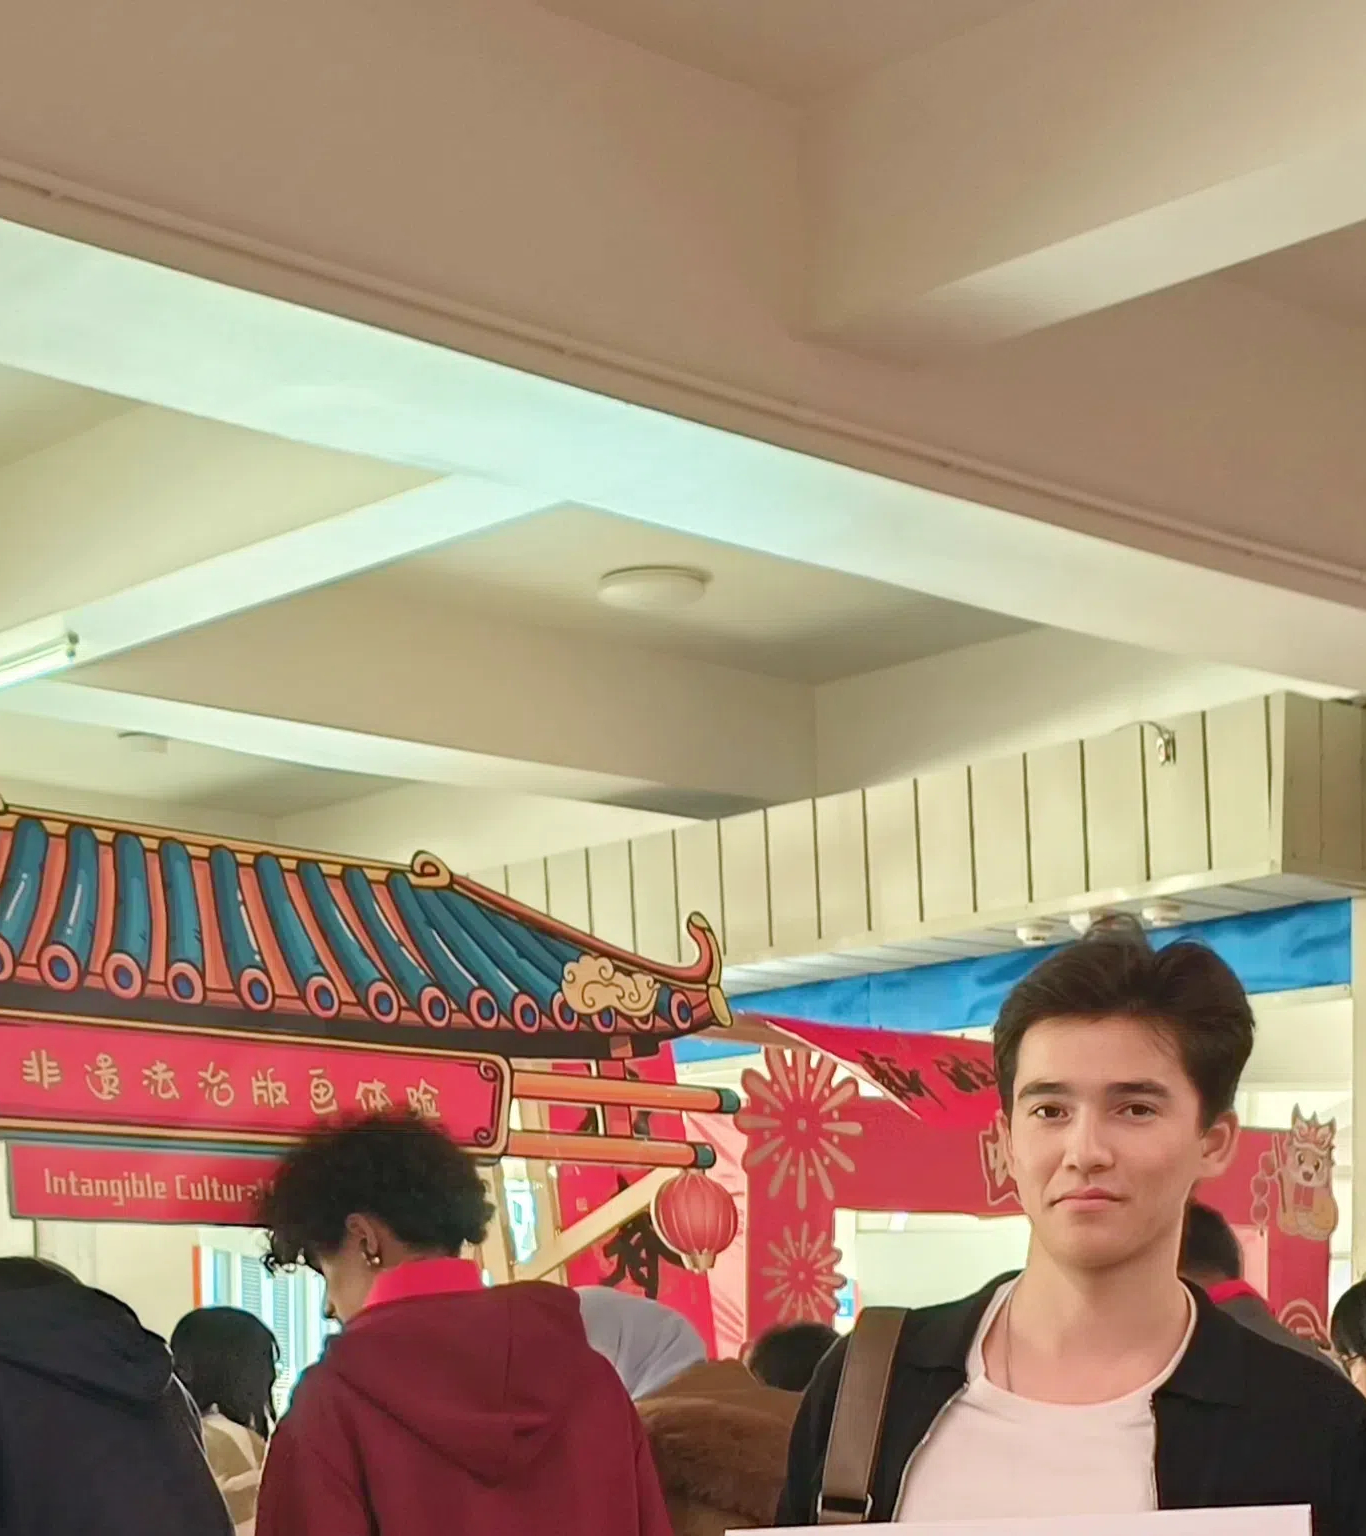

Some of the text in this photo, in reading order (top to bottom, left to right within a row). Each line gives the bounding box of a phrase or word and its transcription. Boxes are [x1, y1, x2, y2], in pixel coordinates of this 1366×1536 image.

[22, 1050, 441, 1120] 非遗法治版画体验
[44, 1168, 167, 1206] Intangible
